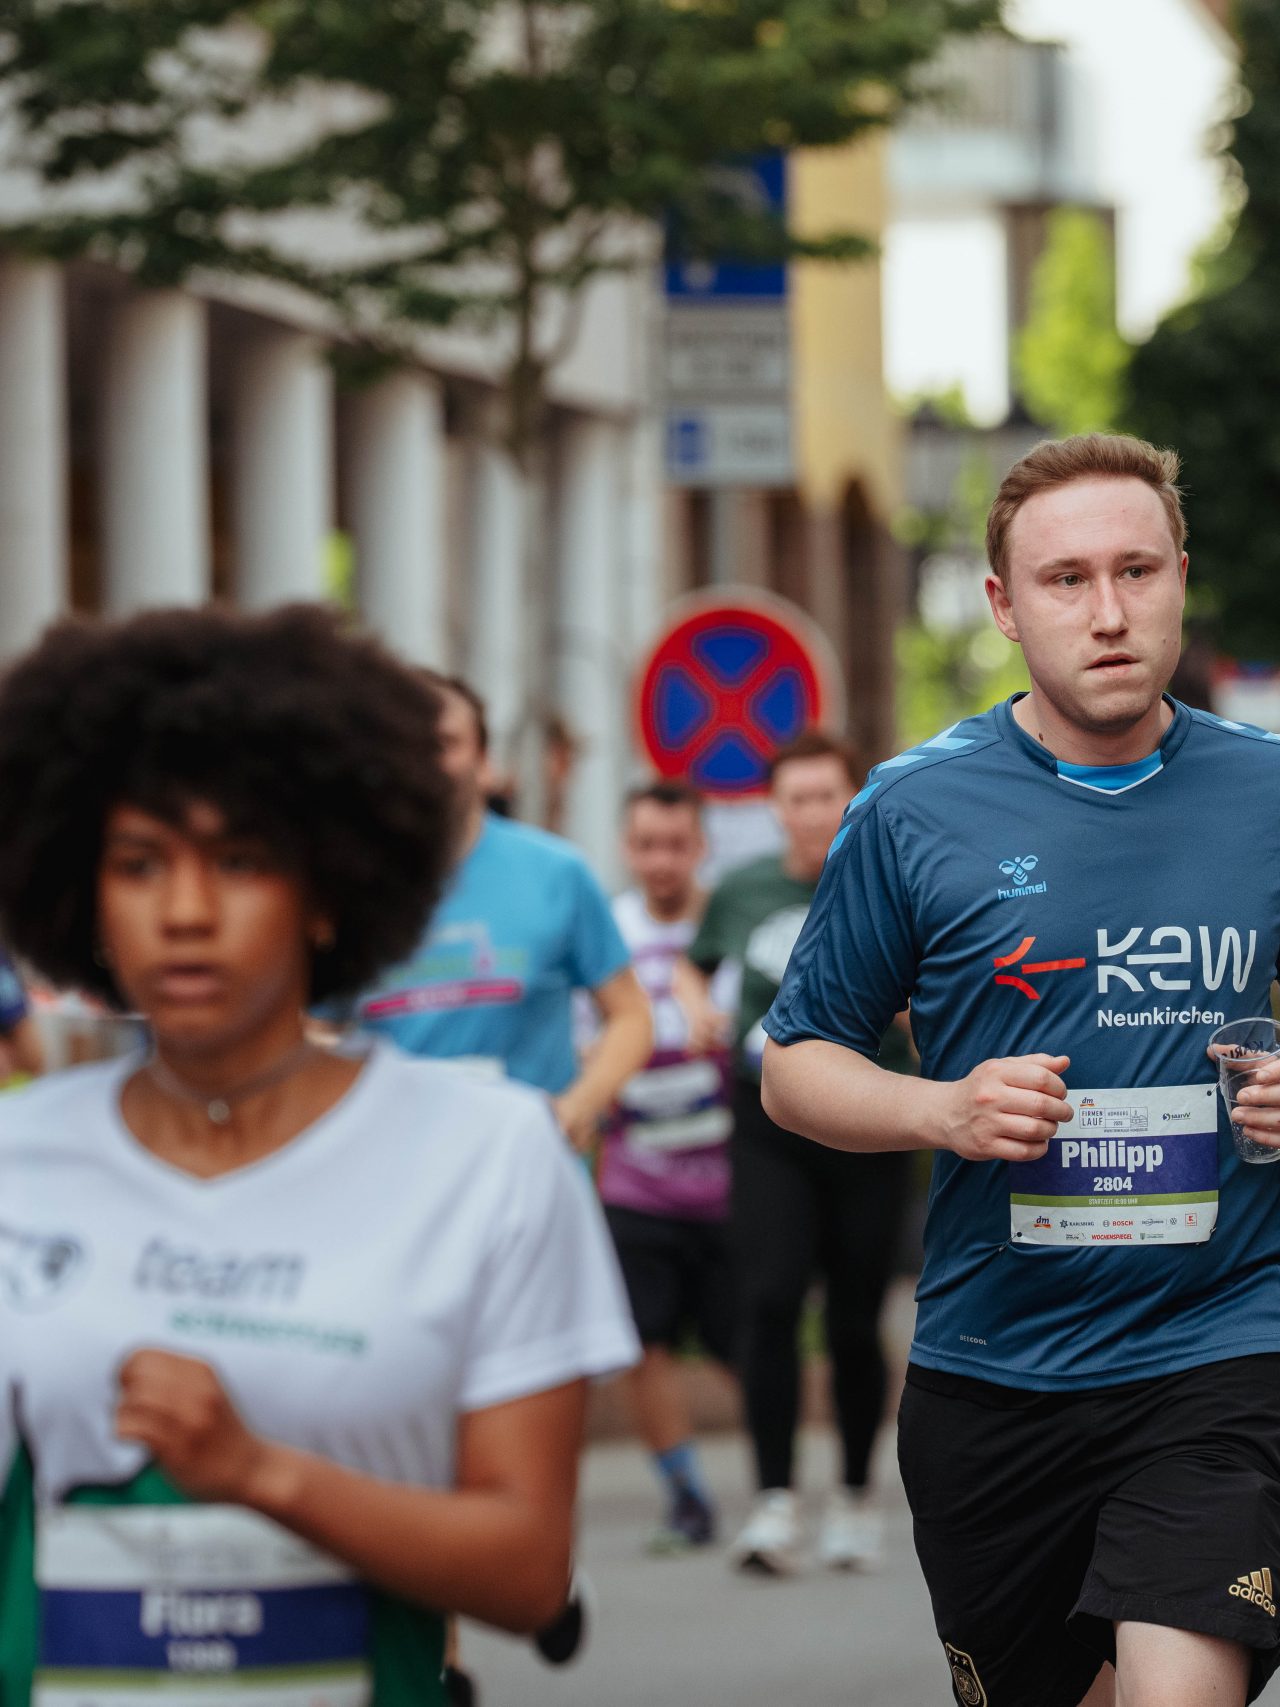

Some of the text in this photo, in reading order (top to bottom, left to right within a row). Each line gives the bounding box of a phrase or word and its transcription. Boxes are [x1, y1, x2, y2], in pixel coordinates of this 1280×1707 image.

[998, 881, 1046, 900] hummel
[1097, 1006, 1225, 1027] Neunkirchen
[1082, 1118, 1103, 1127] LAUF
[1061, 1140, 1164, 1173] Philipp
[1093, 1176, 1133, 1192] 2804
[1036, 1216, 1050, 1224] dm
[134, 1236, 304, 1302] team
[1228, 1584, 1276, 1617] adidas
